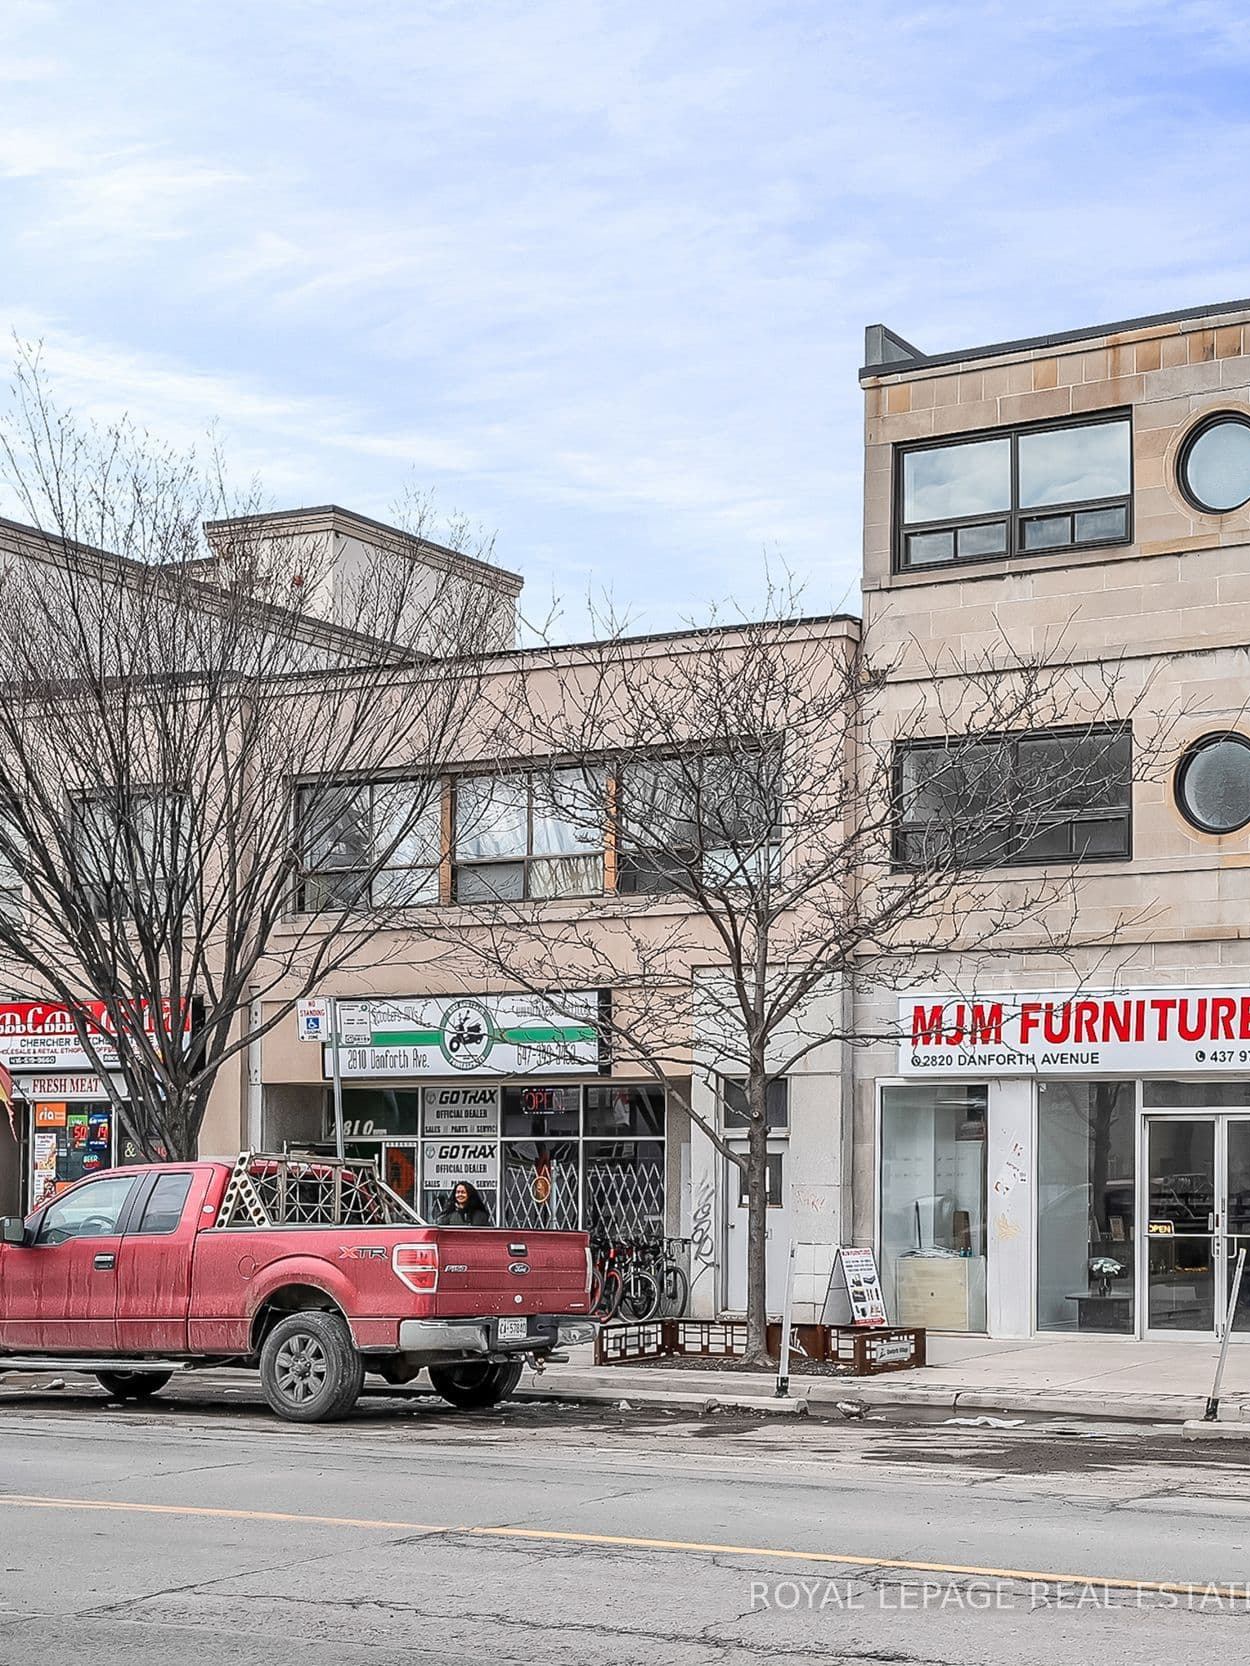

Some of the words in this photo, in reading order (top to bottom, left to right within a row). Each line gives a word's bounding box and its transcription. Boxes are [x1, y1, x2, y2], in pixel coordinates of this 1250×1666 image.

[299, 1009, 325, 1017] STANDING
[912, 1003, 1003, 1046] MJM
[20, 1038, 71, 1047] CHERCHER
[347, 1049, 367, 1069] 2810
[371, 1048, 409, 1069] Danforth
[412, 1047, 430, 1069] Ave.
[923, 1055, 953, 1067] 2820
[957, 1053, 1035, 1066] DANFORTH
[1040, 1051, 1100, 1065] AVENUE
[1209, 1050, 1234, 1063] 437
[32, 1078, 67, 1093] FRESH
[70, 1078, 99, 1093] MEAT
[525, 1091, 562, 1110] OPEN
[39, 1107, 54, 1120] ria
[436, 1110, 463, 1118] OFFICIAL
[465, 1109, 487, 1118] DEALER
[74, 1126, 87, 1138] 50
[436, 1164, 463, 1173] OFFICIAL
[465, 1163, 487, 1173] DEALER
[1149, 1224, 1171, 1233] OPEN
[338, 1246, 389, 1260] XTR
